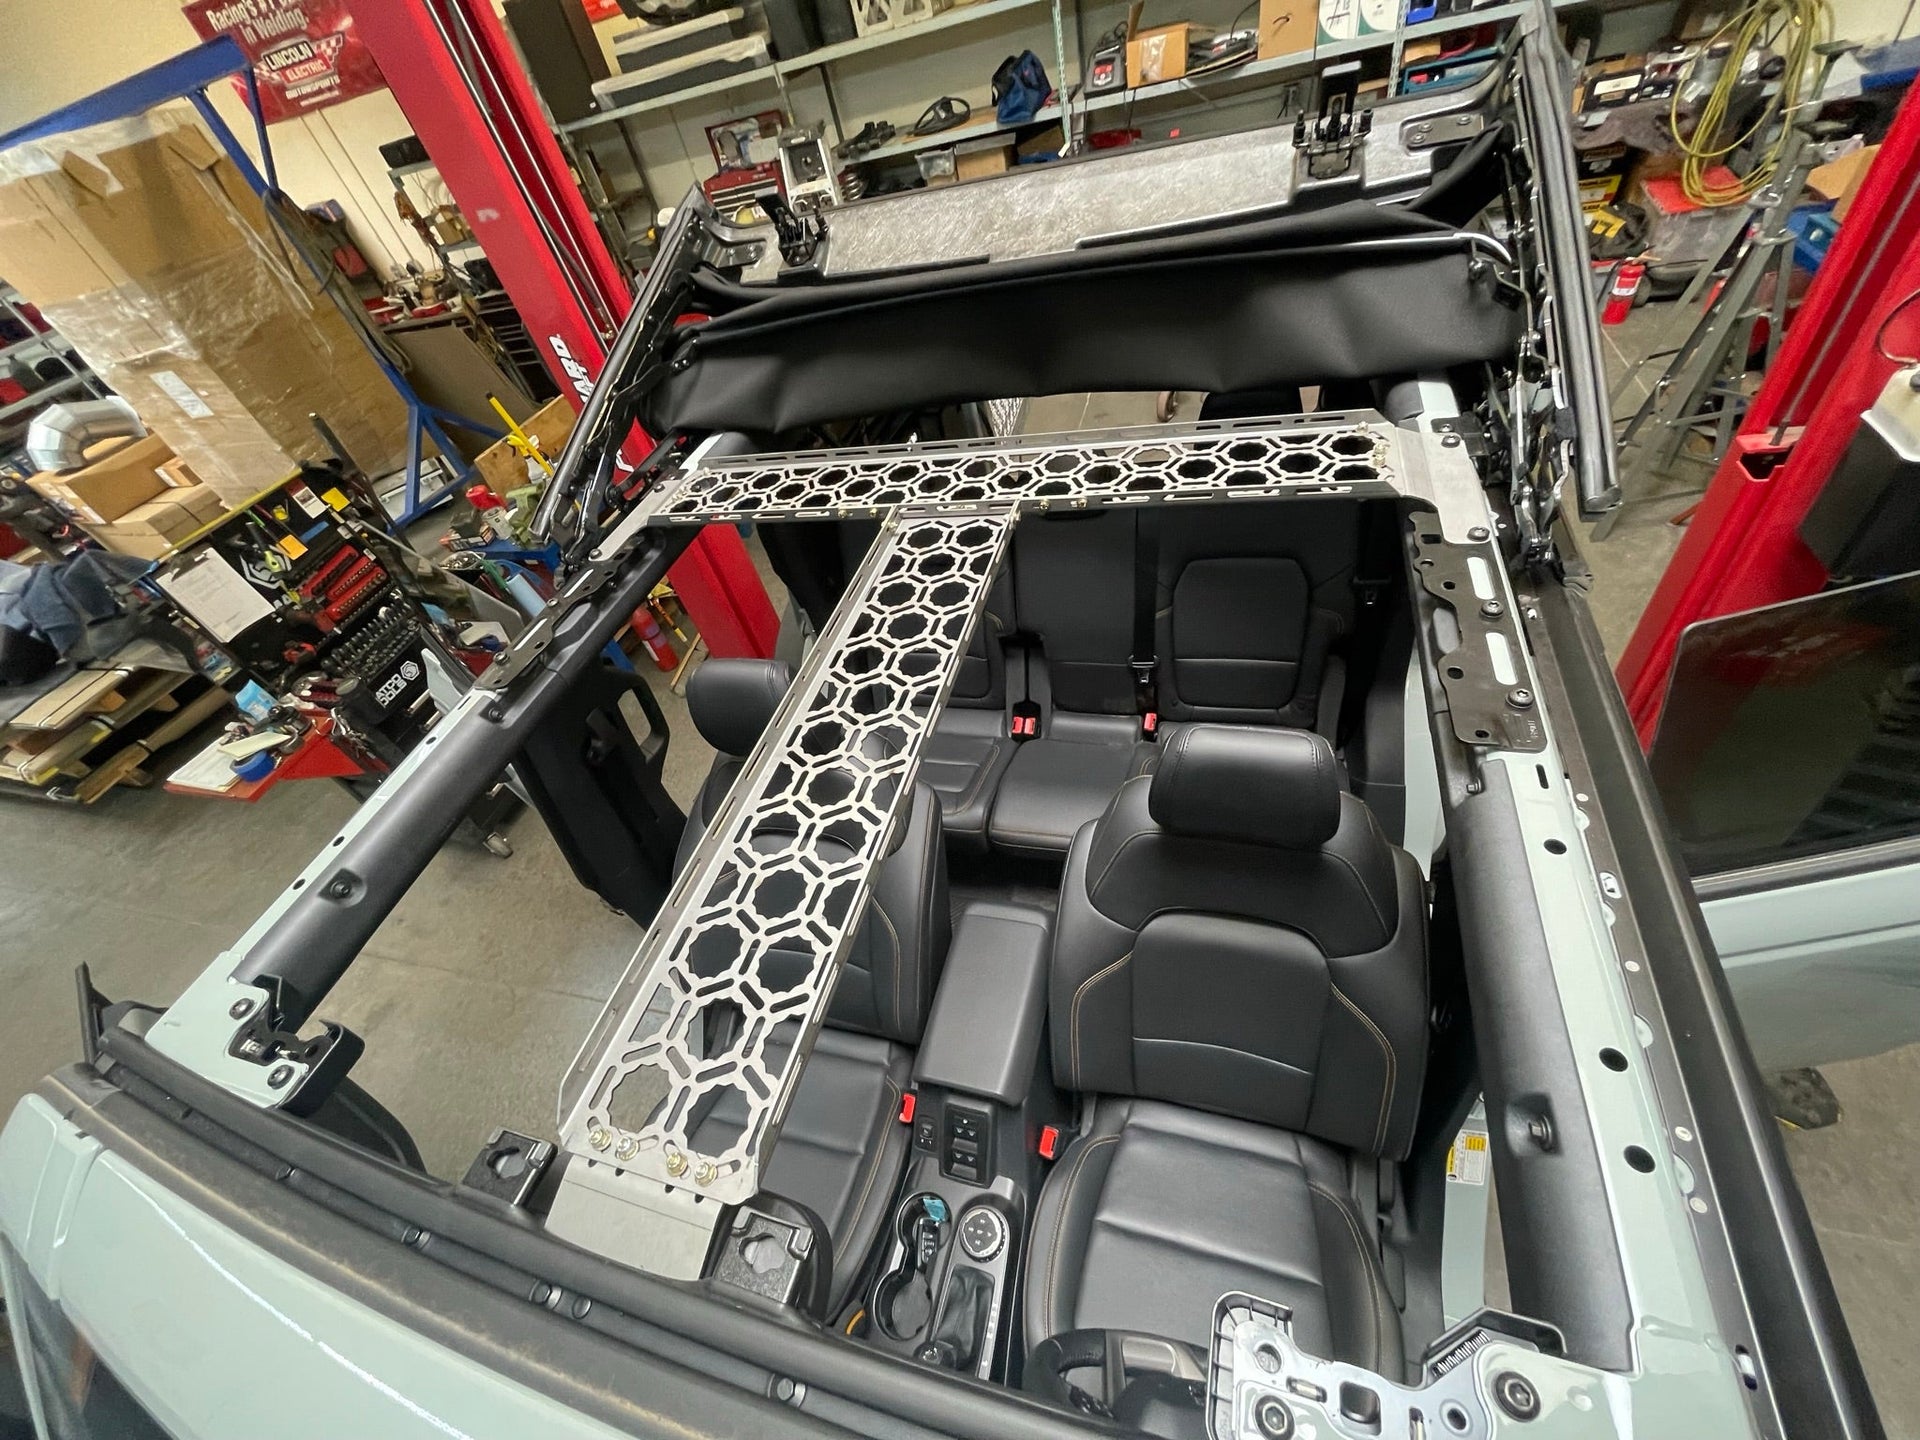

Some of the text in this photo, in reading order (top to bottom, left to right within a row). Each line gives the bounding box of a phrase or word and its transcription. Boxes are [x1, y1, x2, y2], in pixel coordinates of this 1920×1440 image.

[206, 0, 257, 32] Racing's
[239, 8, 310, 44] in Welding.
[265, 43, 313, 70] LINCOLN
[286, 59, 327, 82] ELECTRIC
[376, 674, 402, 700] ATCO
[380, 679, 407, 706] OOLS
